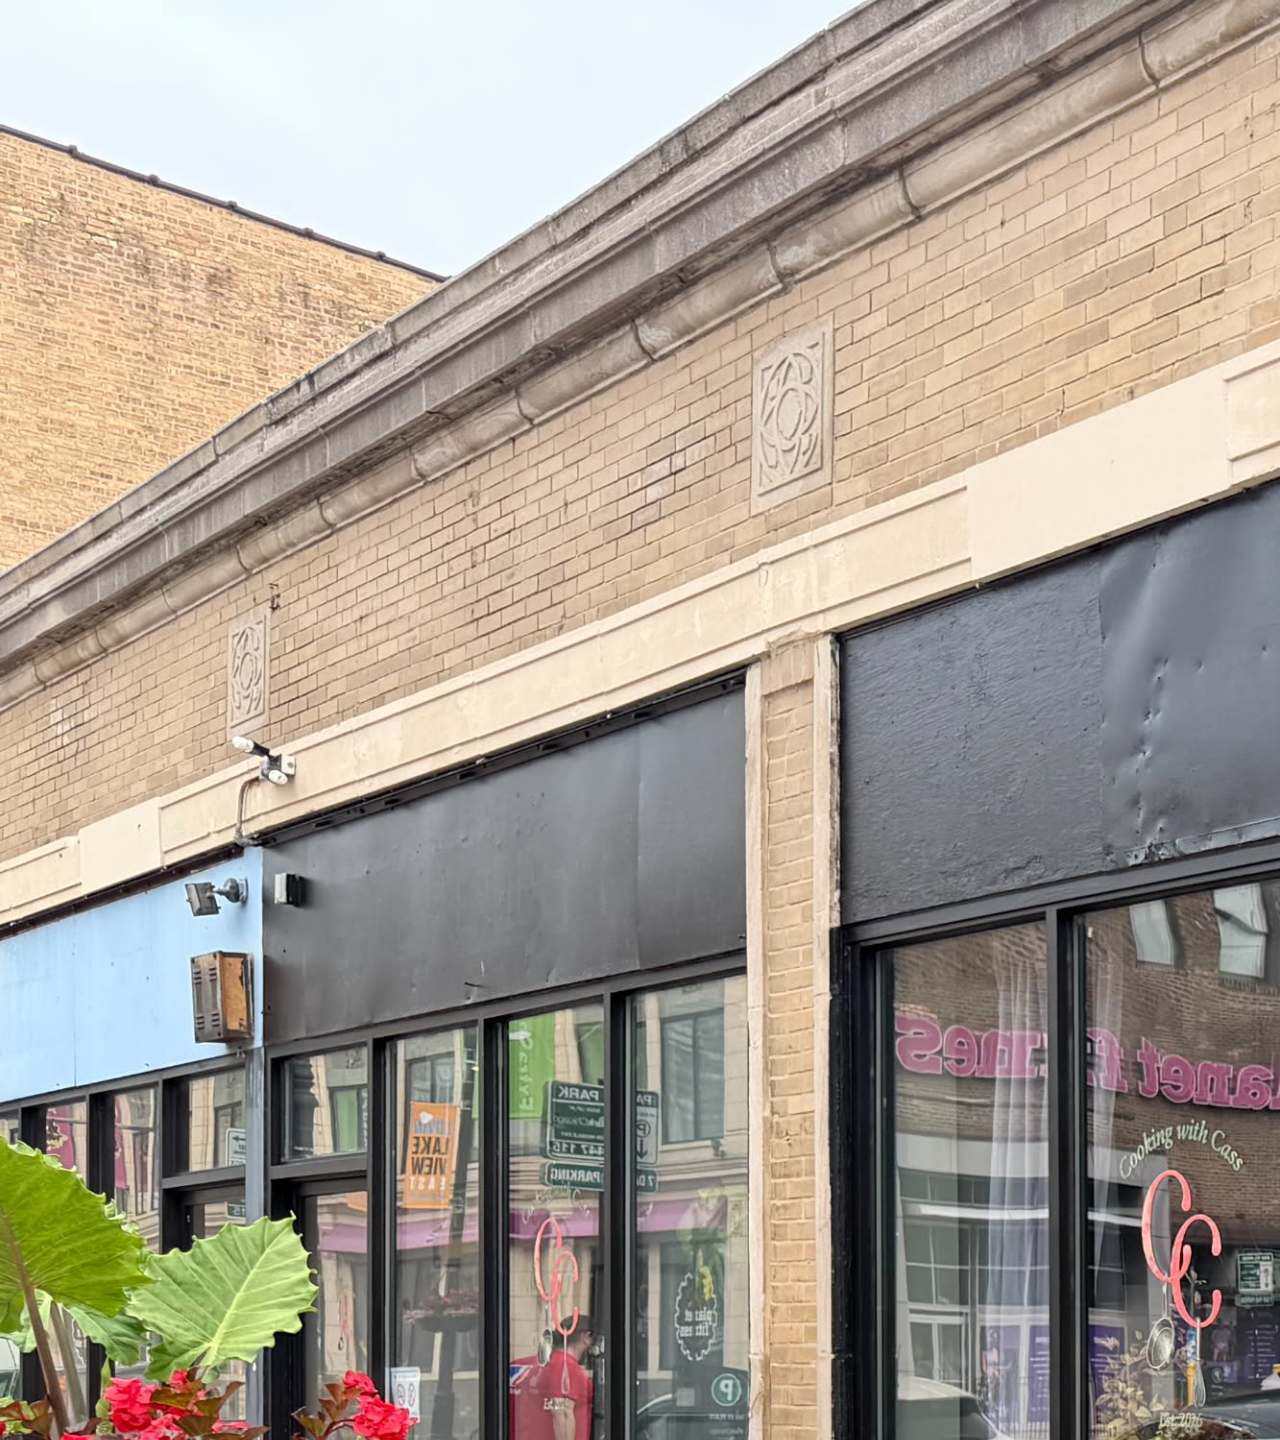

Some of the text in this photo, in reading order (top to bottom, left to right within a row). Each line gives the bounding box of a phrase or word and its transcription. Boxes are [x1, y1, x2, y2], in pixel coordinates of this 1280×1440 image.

[1119, 1119, 1245, 1180] Cooking with Cass
